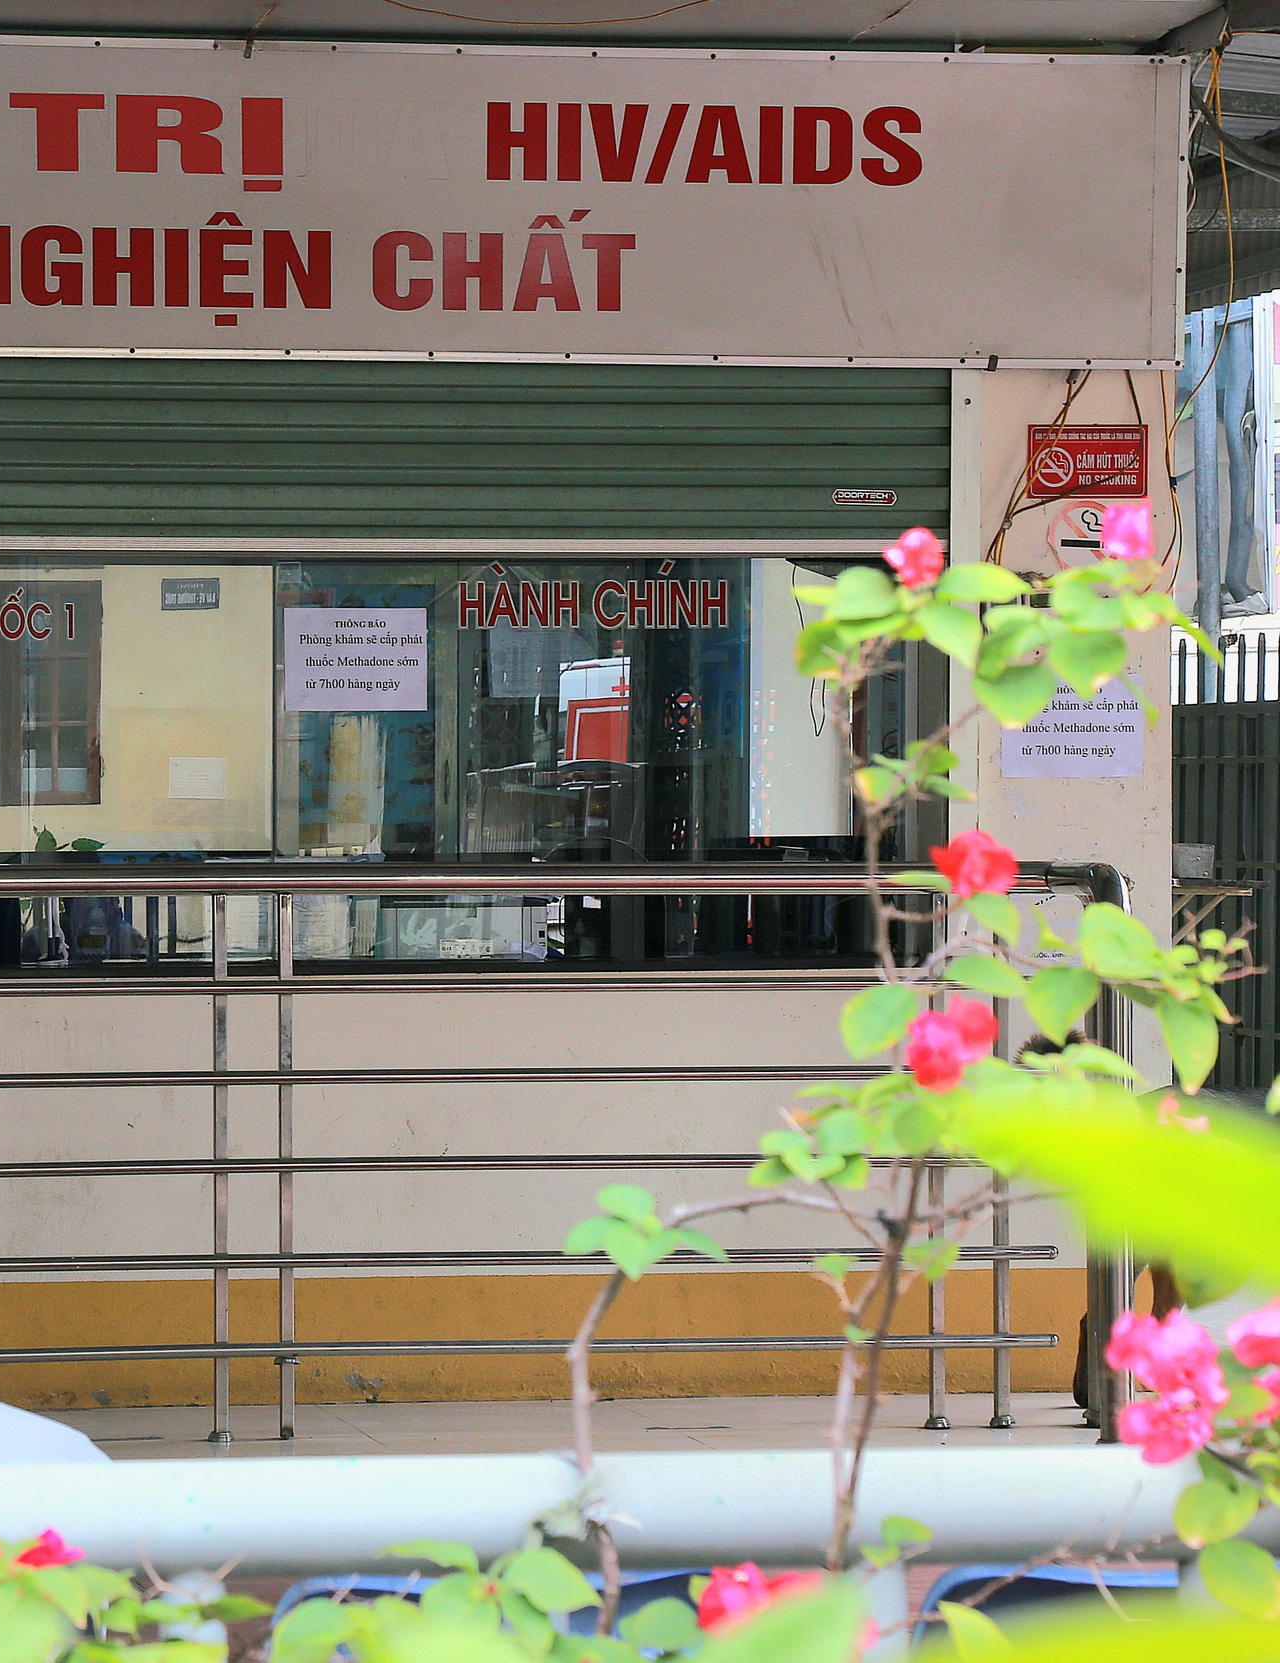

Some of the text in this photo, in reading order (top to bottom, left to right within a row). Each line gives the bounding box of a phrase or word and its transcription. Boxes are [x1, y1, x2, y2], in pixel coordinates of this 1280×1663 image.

[10, 93, 283, 191] TRỊ
[487, 102, 922, 186] HIV/AIDS
[373, 207, 635, 311] CHẤT
[1076, 449, 1139, 469] CẤM HÚT THUỐC
[1078, 475, 1092, 484] NO
[837, 491, 888, 499] DOORTECH
[458, 559, 729, 630] HÀNH CHÍNH
[64, 602, 75, 639] 1
[334, 619, 386, 628] THÔNG BÁO
[299, 632, 423, 646] Phòng khám sẽ cấp phát
[305, 654, 419, 667] thuốc Methadone sớm
[305, 678, 401, 691] từ 7h00 hàng ngày
[1052, 700, 1080, 710] khám
[1082, 701, 1093, 710] sẽ
[1096, 698, 1114, 712] cấp
[1117, 700, 1138, 712] phát
[1053, 723, 1110, 733] Methadone
[1113, 722, 1135, 733] sớm
[1021, 745, 1116, 757] từ 7h00 hàng ngày
